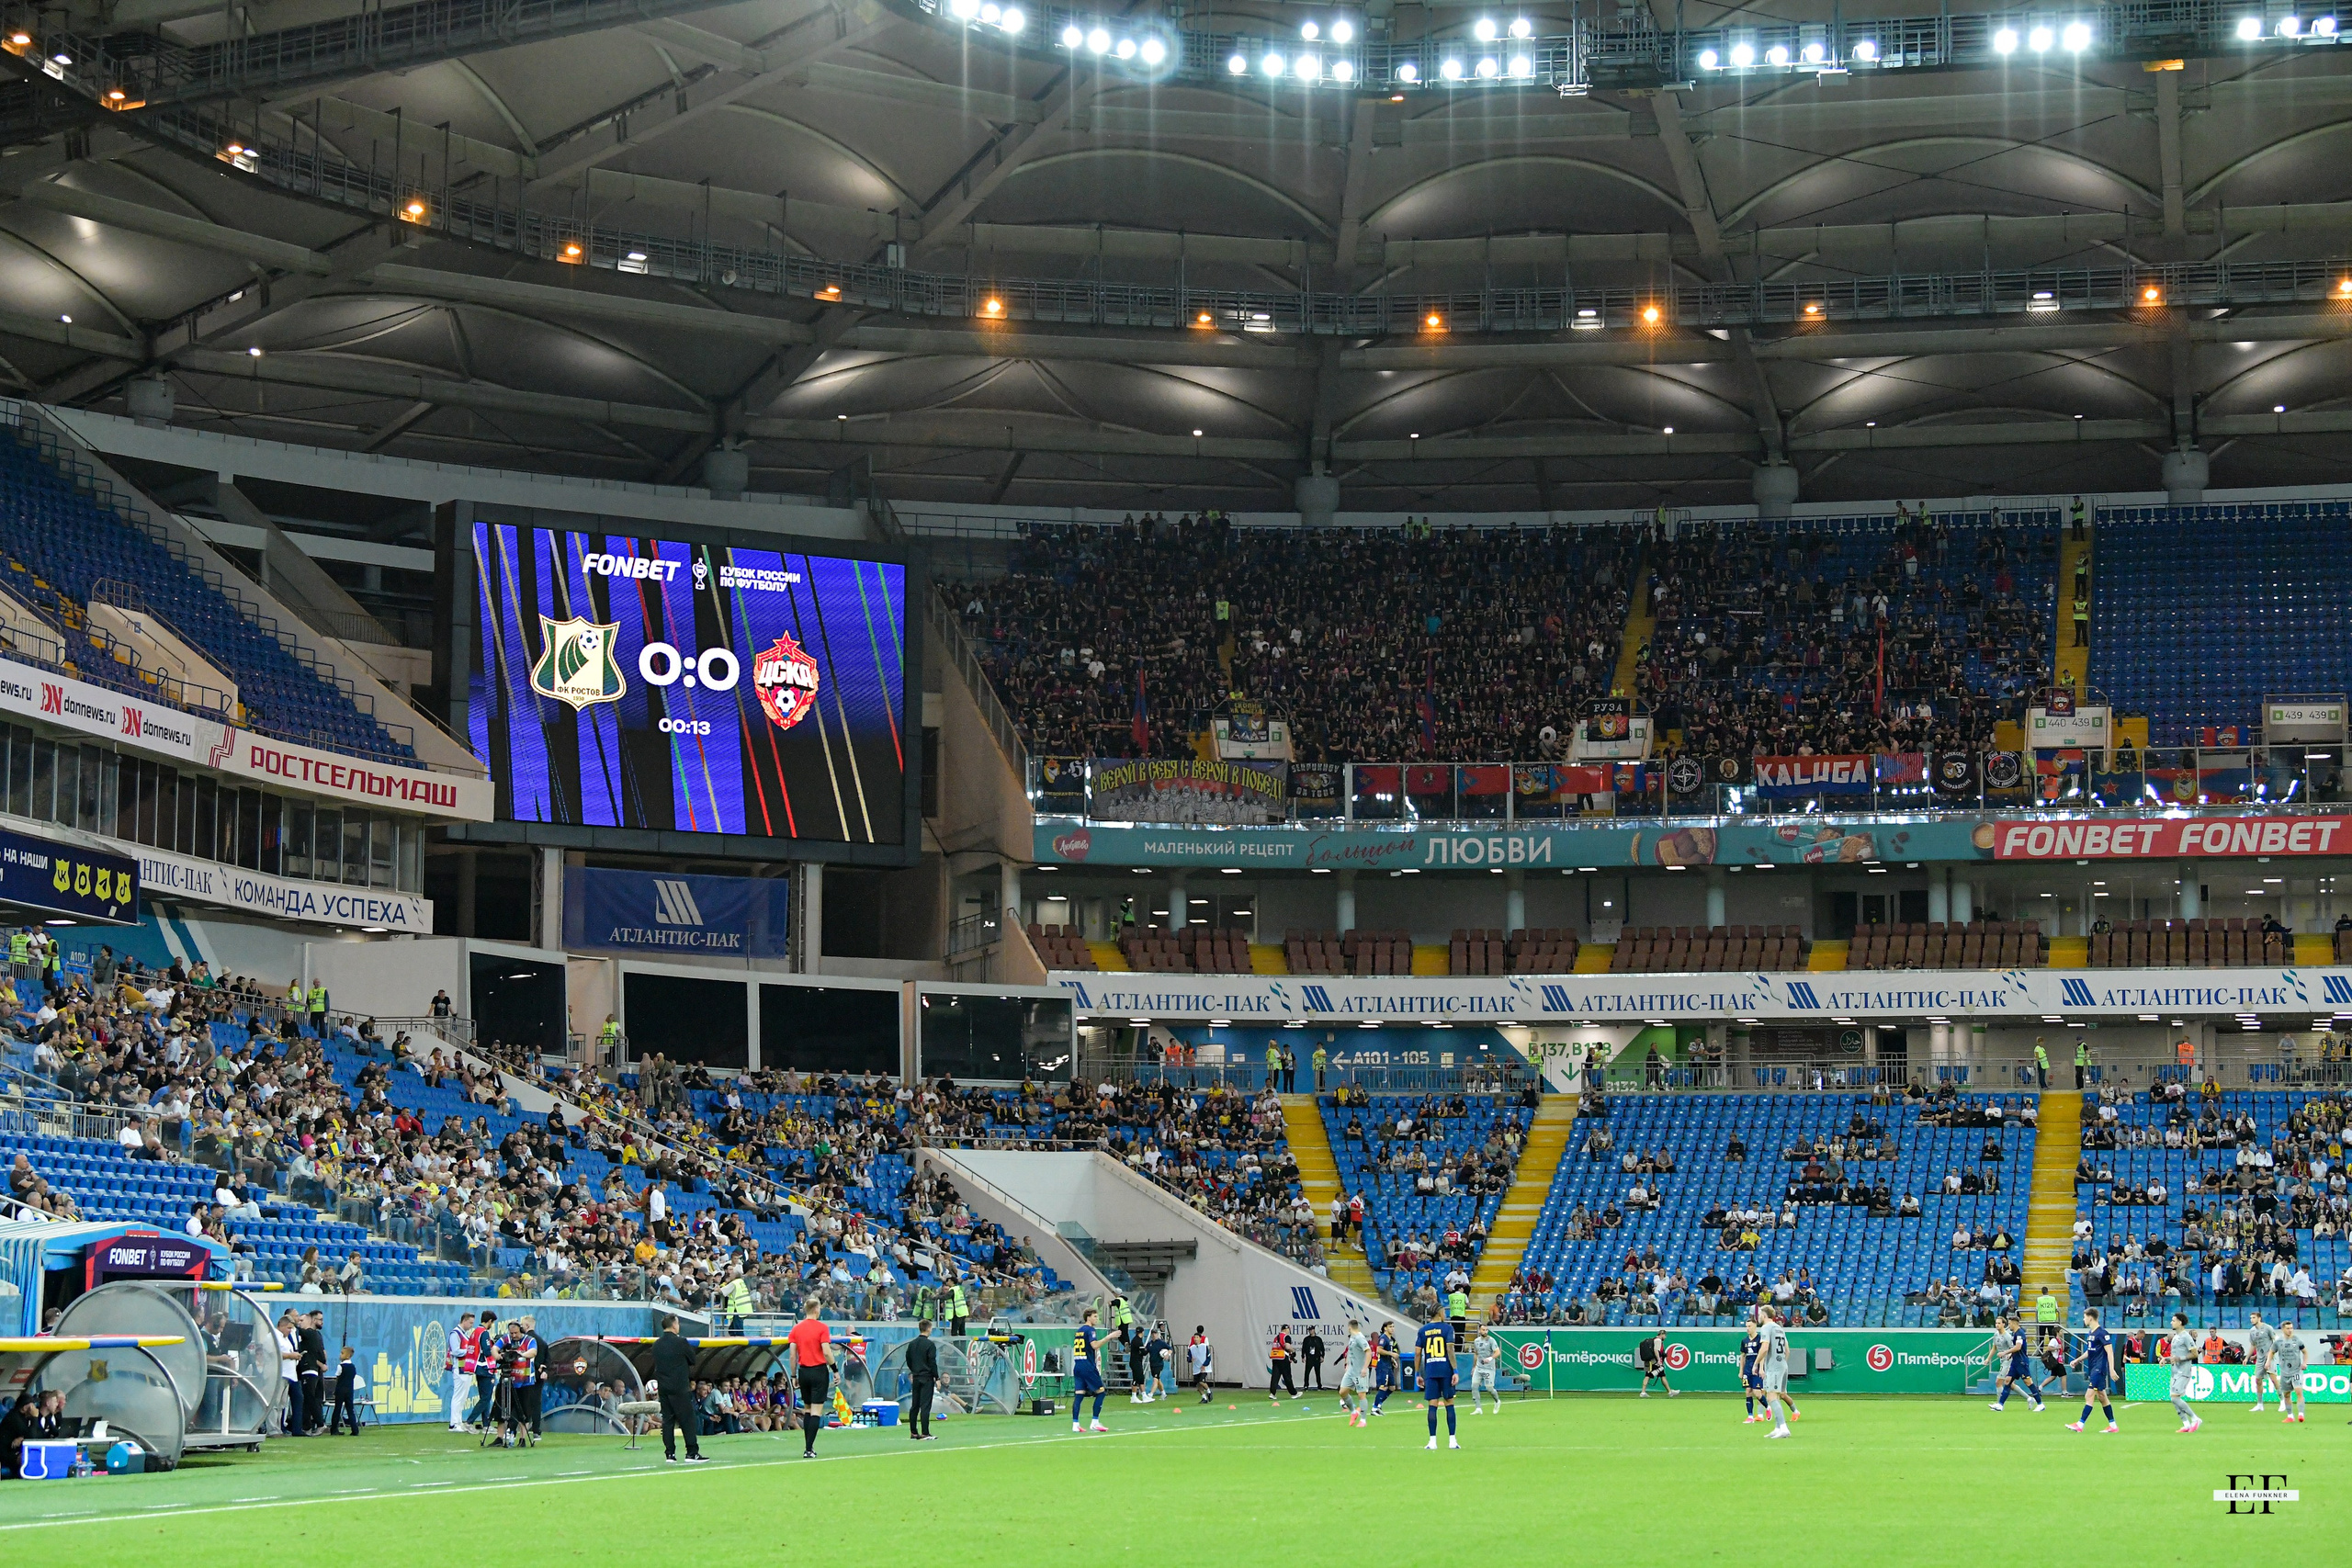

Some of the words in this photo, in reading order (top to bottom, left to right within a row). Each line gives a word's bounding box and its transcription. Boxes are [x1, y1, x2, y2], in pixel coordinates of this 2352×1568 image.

[582, 554, 681, 581] FONBET
[720, 566, 755, 580] КУБОК
[757, 569, 800, 583] РОССИИ
[720, 577, 735, 587] ПО
[736, 579, 787, 592] ФУТБОЛУ
[639, 642, 741, 691] 0:0
[758, 660, 815, 690] ЦСКА
[571, 687, 600, 696] РОСТОВ
[63, 696, 116, 725] donnews.ru
[1593, 703, 1623, 713] РУЗА
[2285, 711, 2302, 719] 439
[2309, 710, 2326, 719] 439
[142, 718, 191, 746] donnews.ru
[658, 717, 711, 735] 00:13
[2048, 718, 2066, 728] 440
[2072, 717, 2089, 727] 439
[251, 746, 457, 808] РОСТСЕЛЬМАШ
[1100, 761, 1137, 794] ВЕРОЙ
[1148, 760, 1178, 780] СЕБЯ
[1192, 760, 1229, 783] ВЕРОЙ
[1756, 760, 1867, 787] KALUGA
[2002, 823, 2164, 857] FONBET
[2177, 820, 2342, 854] FONBET
[4, 848, 17, 863] НА
[19, 851, 48, 870] НАШИ
[1145, 840, 1235, 856] МАЛЕНЬКИЙ
[1240, 843, 1295, 858] РЕЦЕПТ
[1306, 835, 1416, 866] большой
[1424, 836, 1552, 864] ЛЮБВИ
[141, 858, 212, 894] НТИС-ПАК
[234, 877, 317, 916] КОМАНДА
[322, 894, 407, 924] УСПЕХА
[608, 926, 741, 949] АТЛАНТИС-ПАК
[1098, 992, 1271, 1015] АТЛАНТИС-ПАК
[1339, 994, 1516, 1014] АТЛАНТИС-ПАК
[1579, 991, 1757, 1012] АТЛАНТИС-ПАК
[1826, 989, 2007, 1010] АТЛАНТИС-ПАК
[2101, 986, 2288, 1008] АТЛАНТИС-ПАК
[1572, 1042, 1612, 1056] B18
[109, 1247, 147, 1266] FONBET
[160, 1250, 174, 1258] КУБОК
[174, 1250, 191, 1259] РОССИИ
[1266, 1324, 1345, 1336] АТНТС-ПАК
[1073, 1337, 1086, 1356] 22
[1425, 1336, 1445, 1358] 40
[1551, 1350, 1633, 1366] Пятёрочка
[1694, 1351, 1742, 1367] Пятёр
[1897, 1351, 1985, 1368] Пятёрочка
